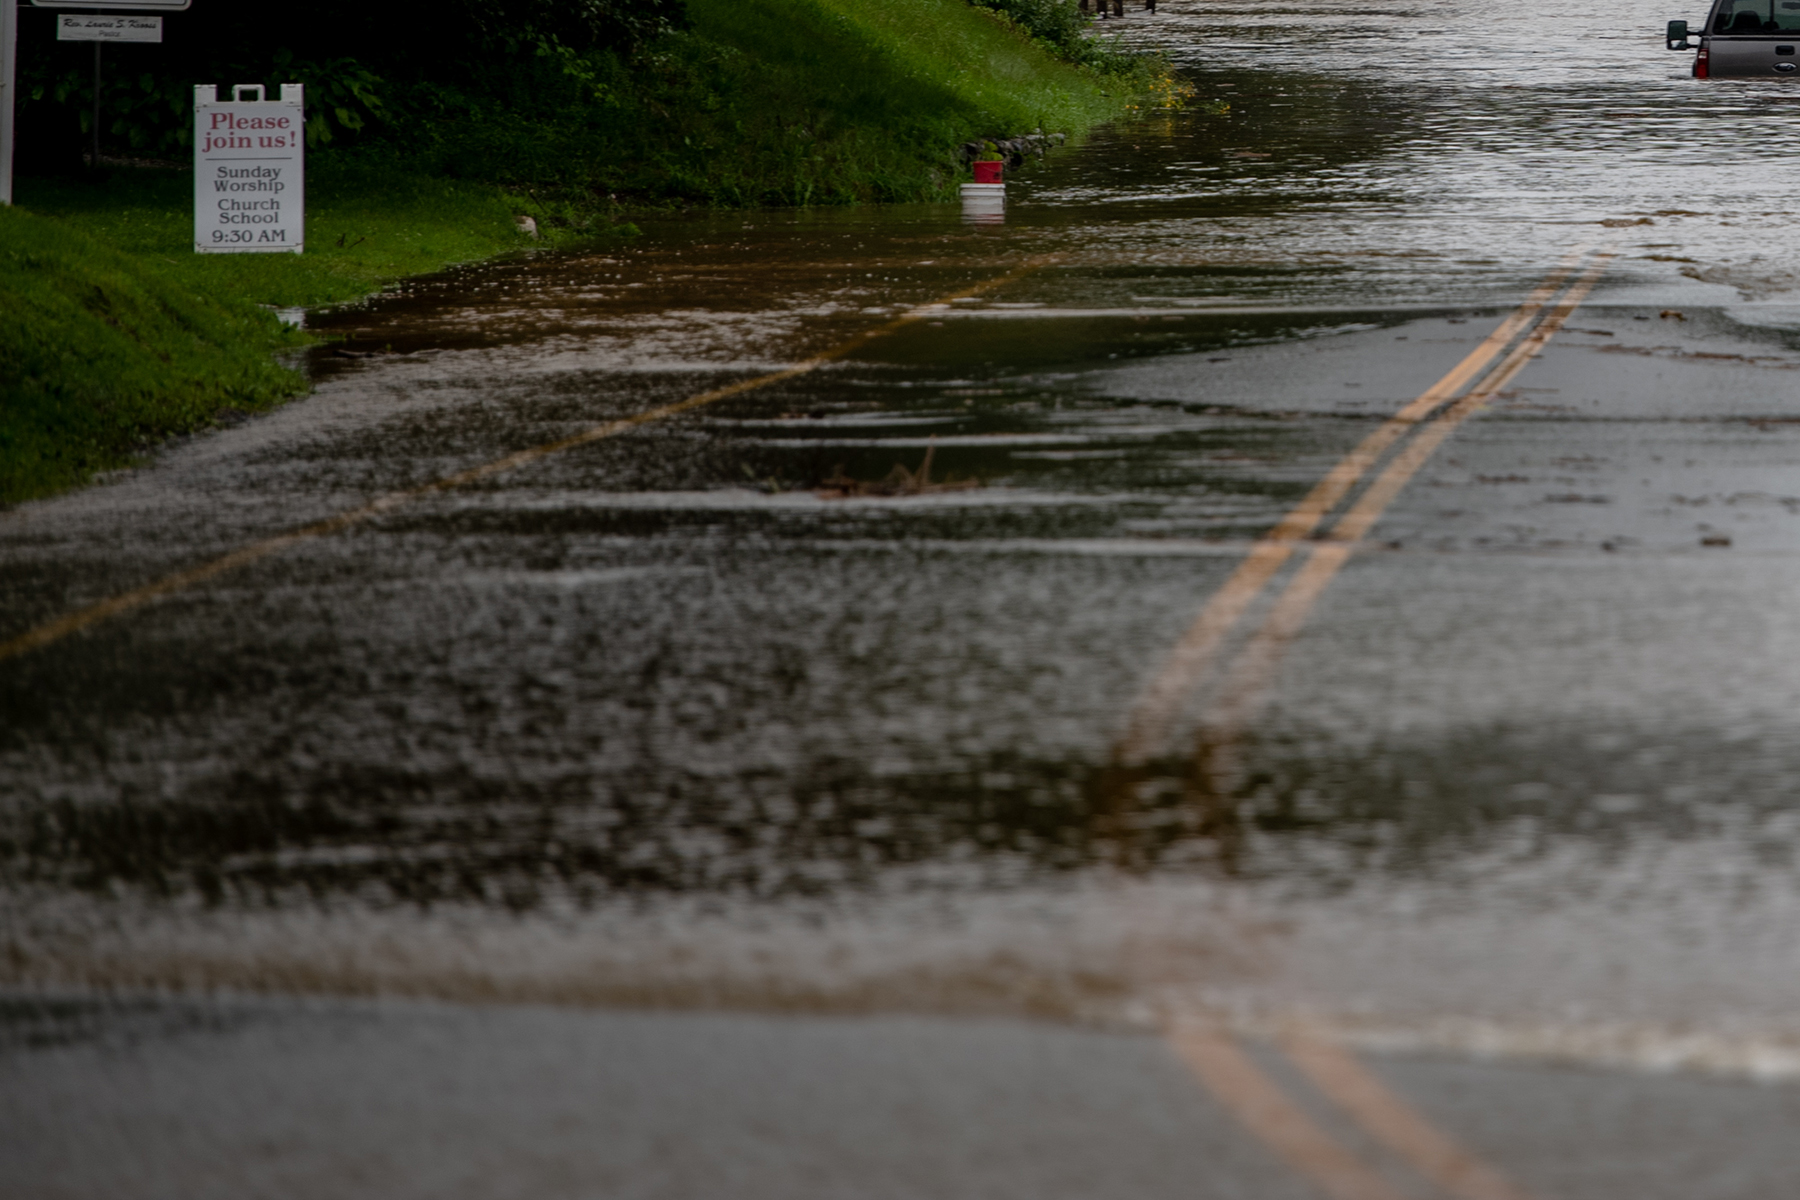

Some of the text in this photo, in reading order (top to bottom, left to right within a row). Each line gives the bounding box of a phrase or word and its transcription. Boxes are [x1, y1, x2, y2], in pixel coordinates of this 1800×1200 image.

[210, 112, 290, 130] Please
[202, 131, 252, 153] join
[217, 166, 282, 181] Sunday
[213, 179, 285, 194] Worship
[217, 198, 281, 211] Church
[219, 212, 279, 224] School
[212, 229, 286, 243] 9:30 AM
